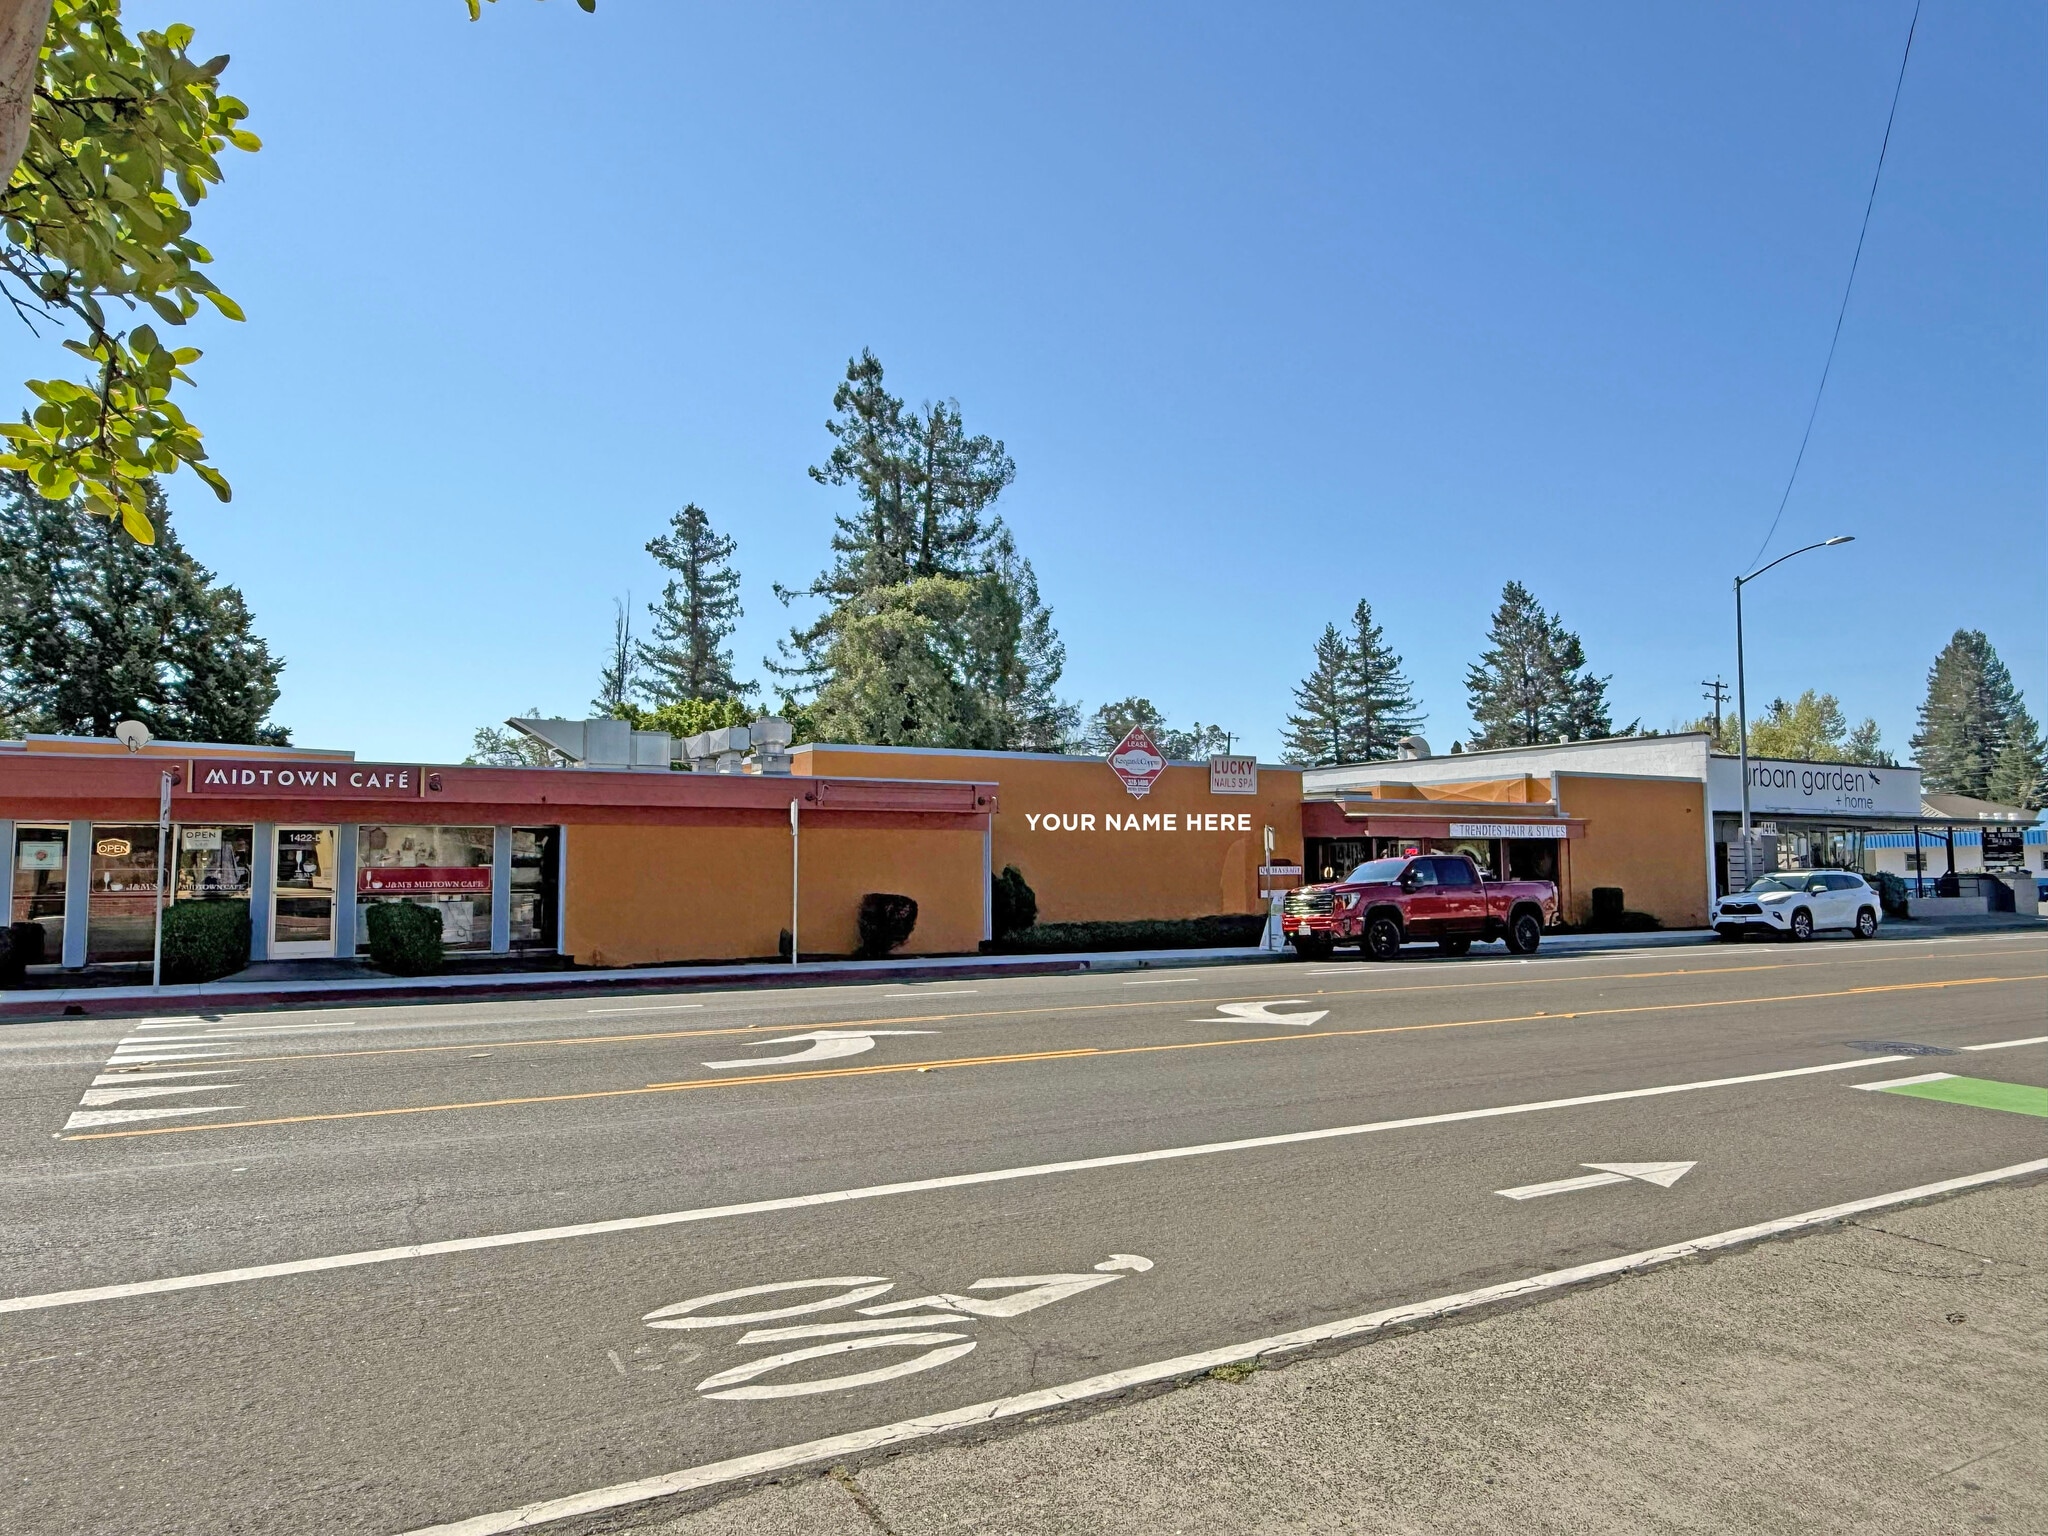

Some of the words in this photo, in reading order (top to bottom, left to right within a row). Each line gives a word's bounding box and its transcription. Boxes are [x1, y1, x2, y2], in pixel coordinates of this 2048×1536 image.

[1131, 733, 1145, 741] FOR
[1127, 740, 1149, 748] LEASE
[1214, 760, 1254, 775] LUCKY
[204, 768, 337, 787] MIDTOWN
[349, 770, 409, 789] CAFÉ
[1214, 777, 1237, 788] NAILS
[1238, 777, 1254, 788] SPA
[1801, 767, 1865, 796] garden
[1844, 793, 1874, 810] home
[1504, 825, 1525, 837] HAIR
[1527, 826, 1534, 837] &
[1536, 826, 1566, 837] STYLES
[1762, 823, 1776, 835] 1414
[186, 831, 216, 839] OPEN
[99, 844, 129, 853] OPEN
[179, 883, 223, 891] MIDTOWN
[385, 881, 412, 889] J&M'S
[414, 880, 460, 889] MIDTOWN
